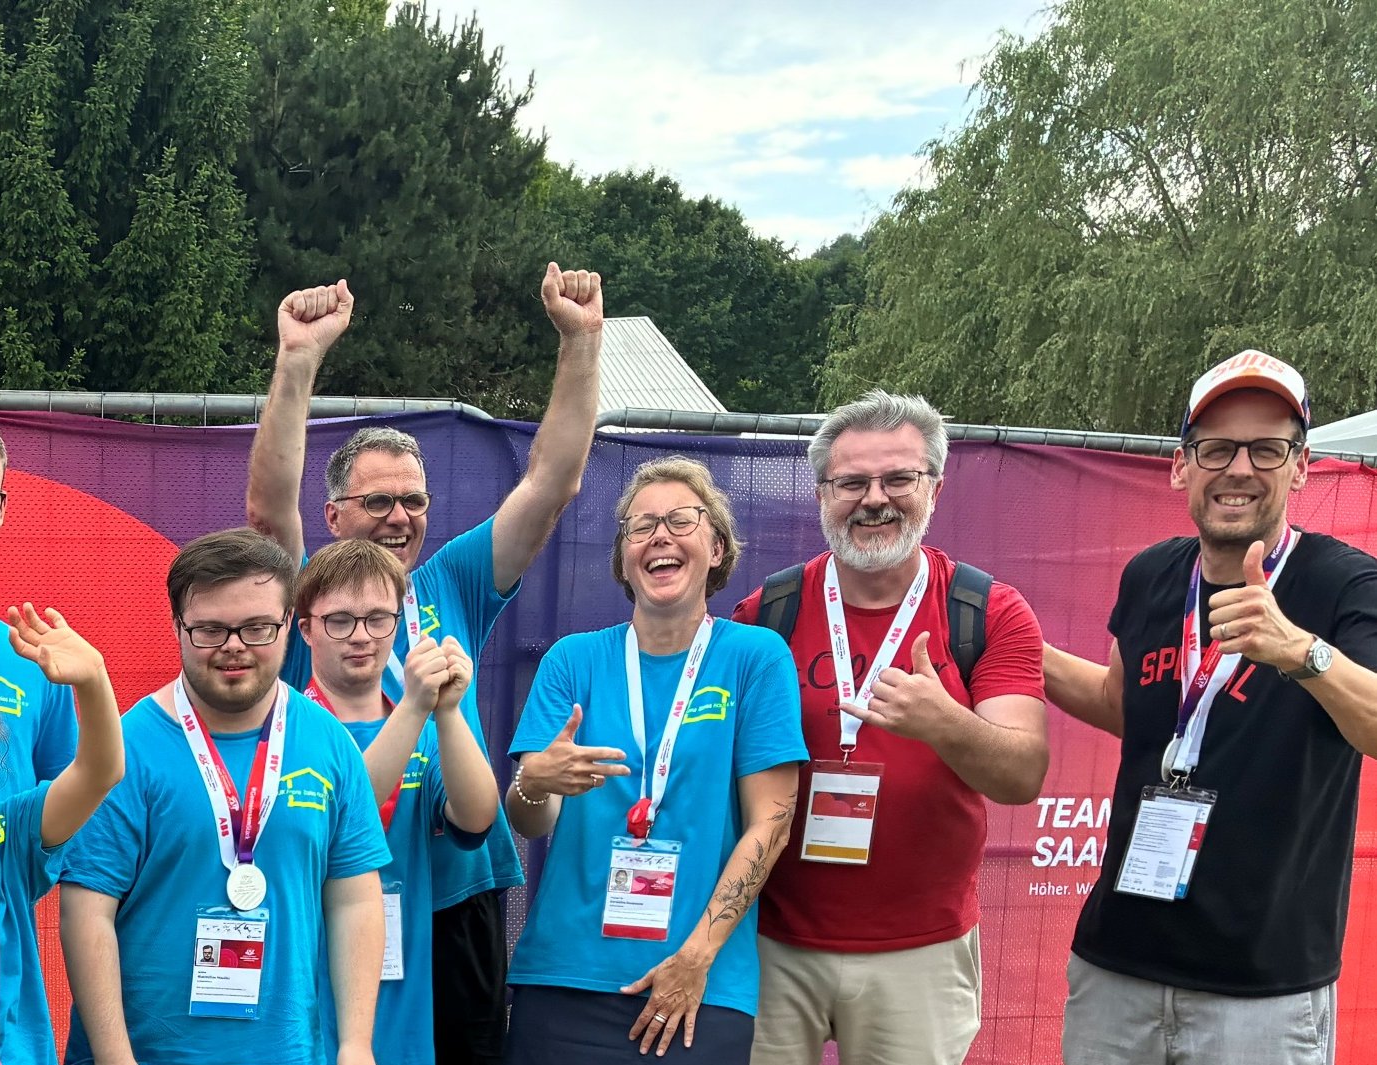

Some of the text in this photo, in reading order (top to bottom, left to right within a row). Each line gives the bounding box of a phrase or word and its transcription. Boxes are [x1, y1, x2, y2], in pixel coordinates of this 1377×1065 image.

[828, 586, 838, 602] ABB
[888, 627, 903, 645] ABB
[1189, 632, 1197, 652] ABB
[841, 681, 851, 698] ABB
[673, 700, 685, 717] ABB
[182, 714, 196, 732] ABB
[269, 754, 279, 773] ABB
[218, 817, 229, 838] ABB
[1031, 836, 1107, 867] SAA
[1029, 881, 1071, 896] Höher.
